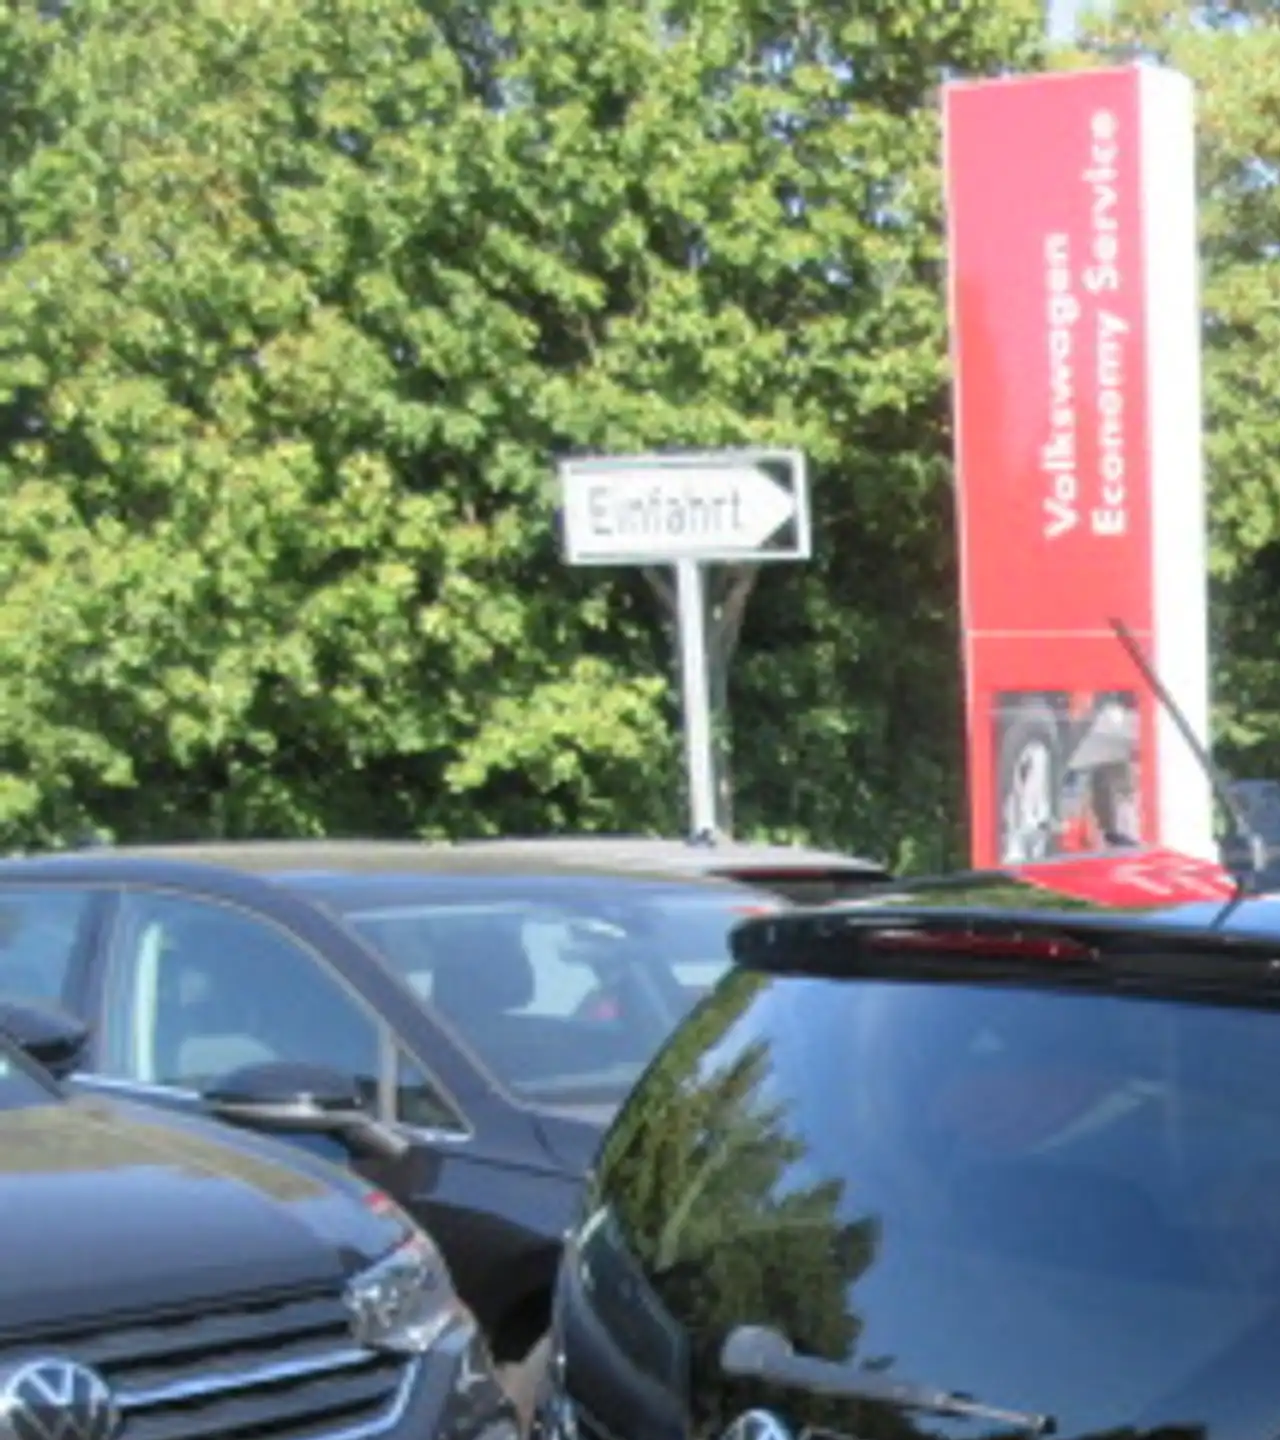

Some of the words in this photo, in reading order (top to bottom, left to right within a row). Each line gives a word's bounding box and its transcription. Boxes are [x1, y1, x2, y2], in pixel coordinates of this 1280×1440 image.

[1081, 108, 1121, 296] Service
[1042, 231, 1081, 539] Volkswagen
[1091, 310, 1130, 537] Economy
[588, 485, 743, 536] Einfahrt
